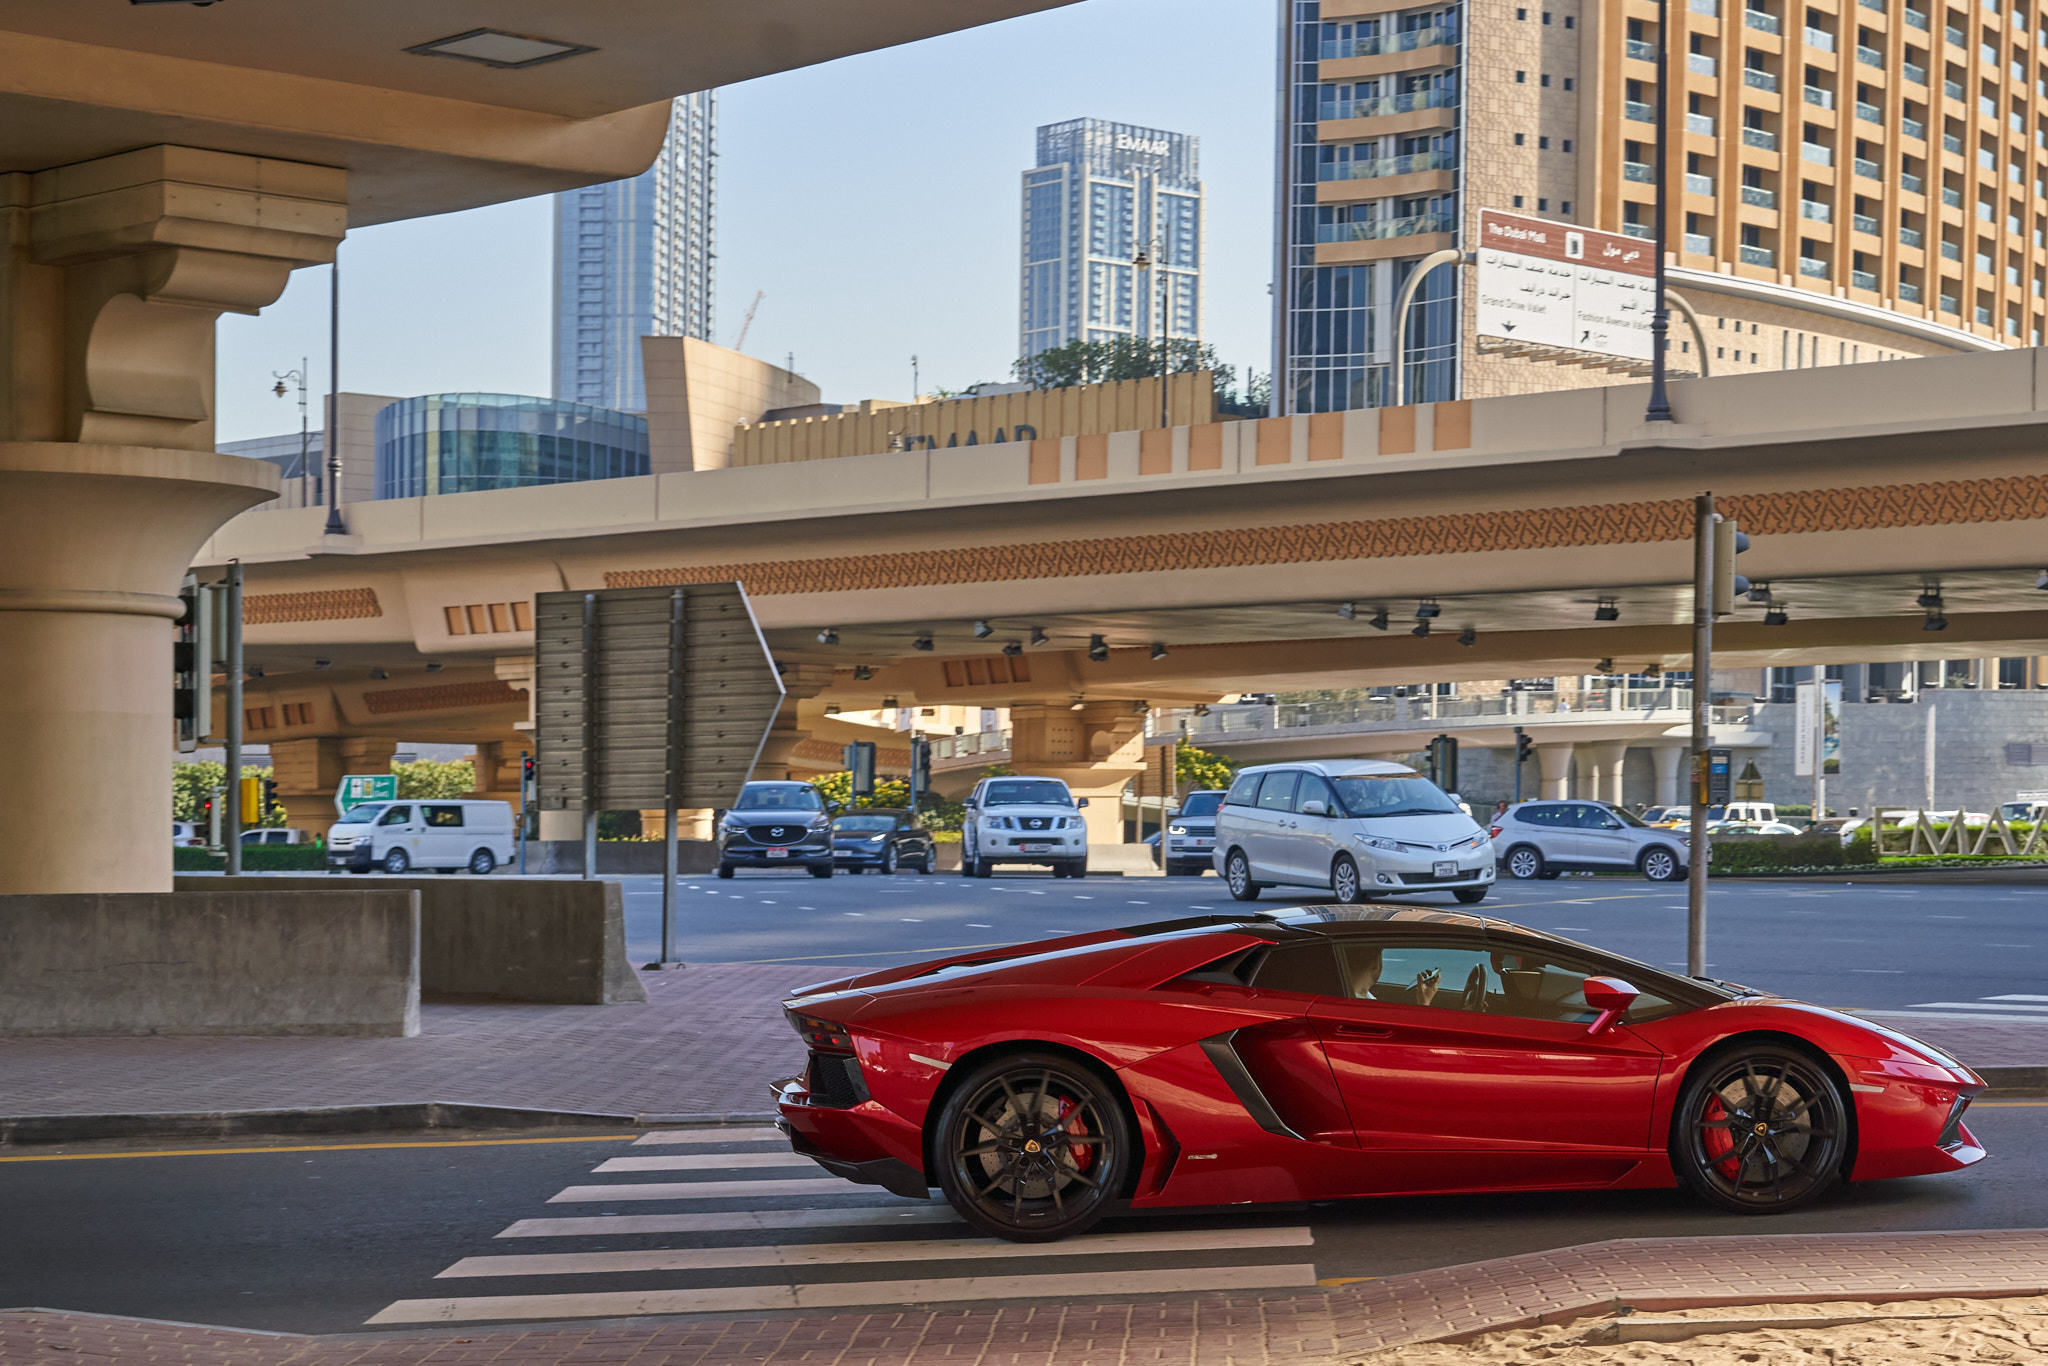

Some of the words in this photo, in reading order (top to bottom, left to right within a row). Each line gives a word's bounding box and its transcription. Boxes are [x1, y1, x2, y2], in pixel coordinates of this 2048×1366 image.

[1117, 133, 1170, 156] EMAAR
[1487, 222, 1504, 236] The
[1503, 225, 1528, 240] Dubai
[1527, 230, 1547, 244] Mall
[1602, 242, 1622, 258] مول
